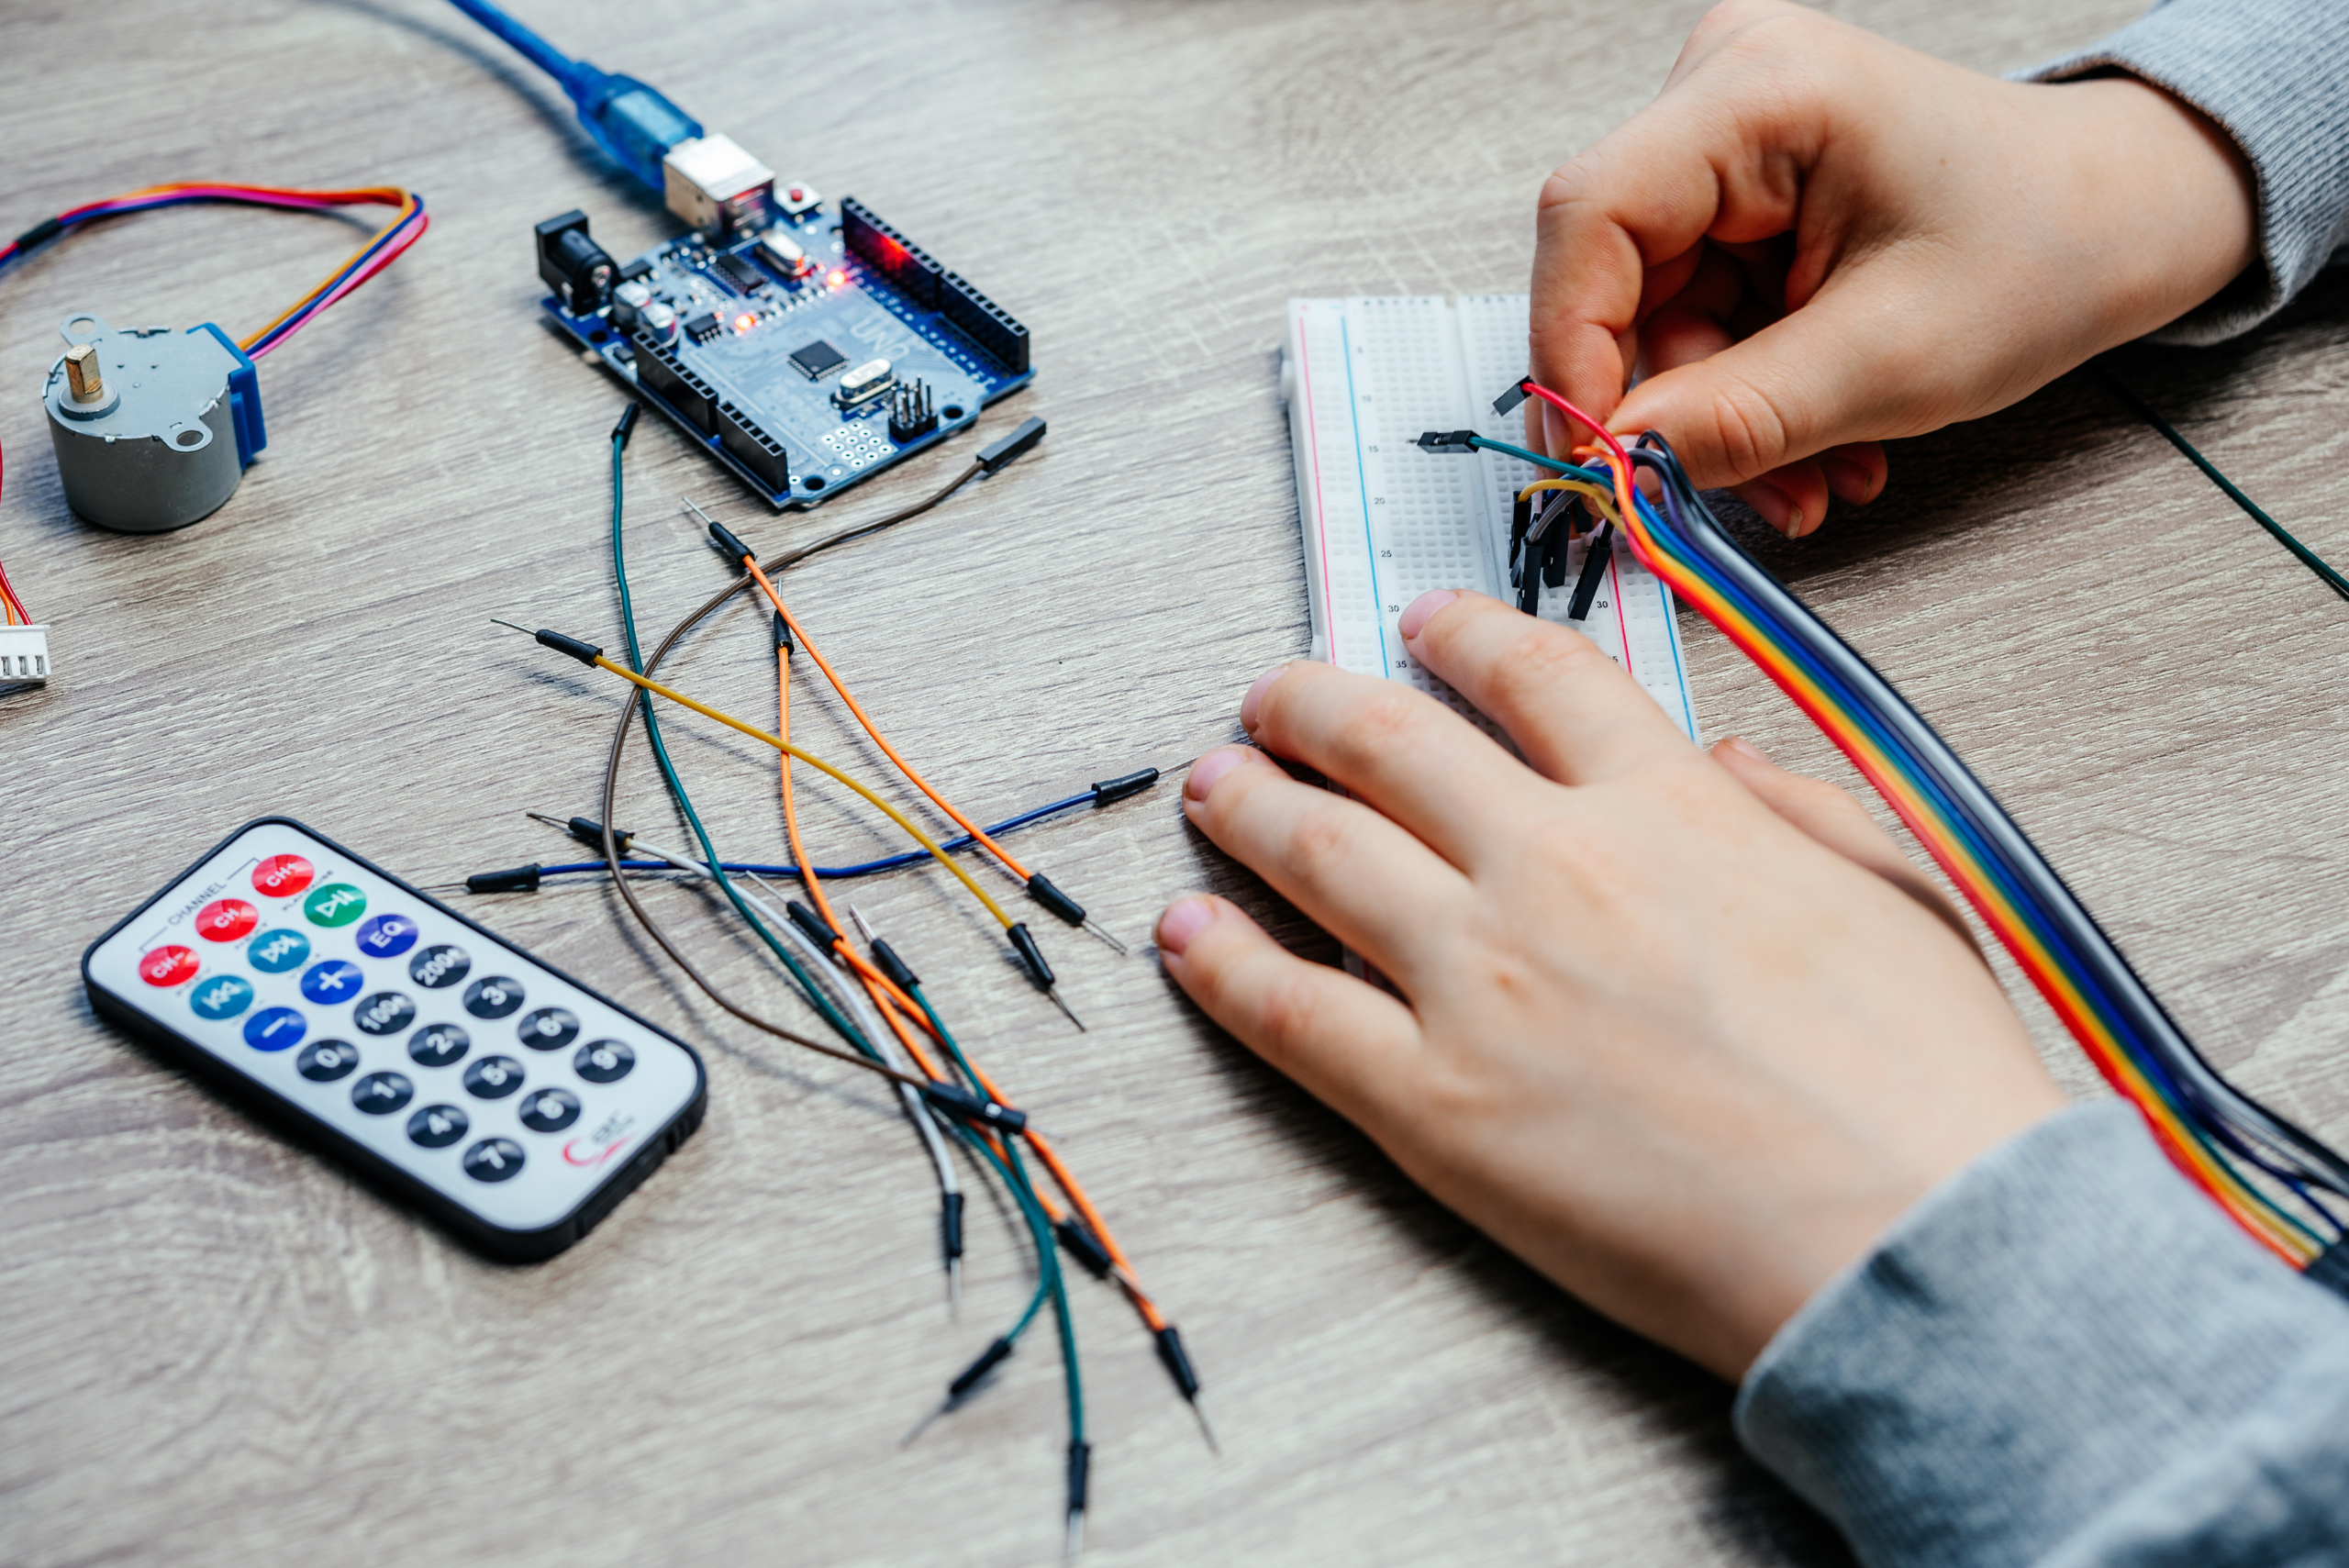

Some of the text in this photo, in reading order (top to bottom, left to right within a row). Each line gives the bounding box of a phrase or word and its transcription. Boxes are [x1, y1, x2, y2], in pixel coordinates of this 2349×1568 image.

[850, 317, 909, 361] UNO
[1388, 605, 1399, 613] 30
[265, 862, 295, 887] CH+
[167, 882, 227, 926] CHANNEL
[214, 908, 239, 929] CH
[369, 920, 405, 949] EQ
[151, 952, 184, 978] CH-
[416, 949, 459, 985] 200+
[482, 985, 507, 1006] 3
[362, 995, 406, 1030] 100+
[537, 1018, 562, 1037] 6
[425, 1033, 454, 1054] 2
[315, 1049, 341, 1068] 0
[591, 1050, 618, 1070] 9
[481, 1065, 507, 1085] 5
[373, 1081, 396, 1099] 1
[537, 1097, 564, 1119] 8
[429, 1113, 452, 1134] 4
[478, 1146, 505, 1170] 7
